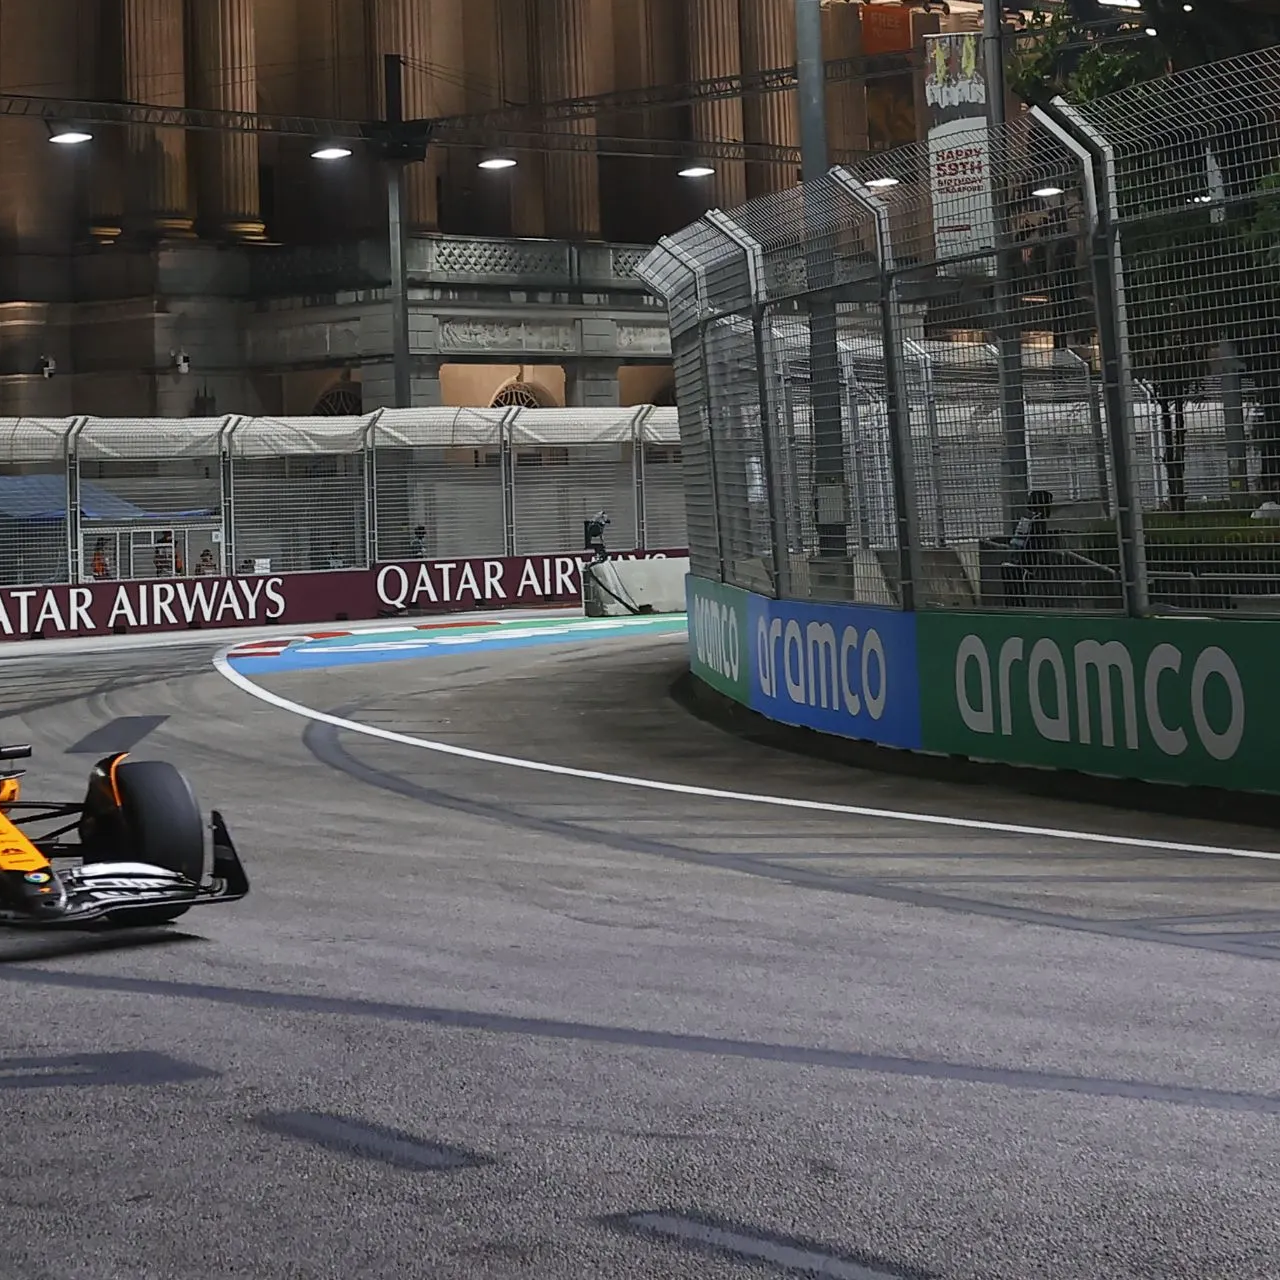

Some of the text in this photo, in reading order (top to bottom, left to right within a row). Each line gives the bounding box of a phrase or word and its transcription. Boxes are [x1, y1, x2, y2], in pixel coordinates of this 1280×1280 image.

[936, 147, 982, 161] HAPPY
[936, 160, 983, 177] 59TH
[108, 577, 287, 628] AIRWAYS
[377, 560, 506, 608] QATAR
[695, 594, 739, 682] aramco
[758, 616, 886, 720] aramco
[956, 634, 1245, 760] aramco
